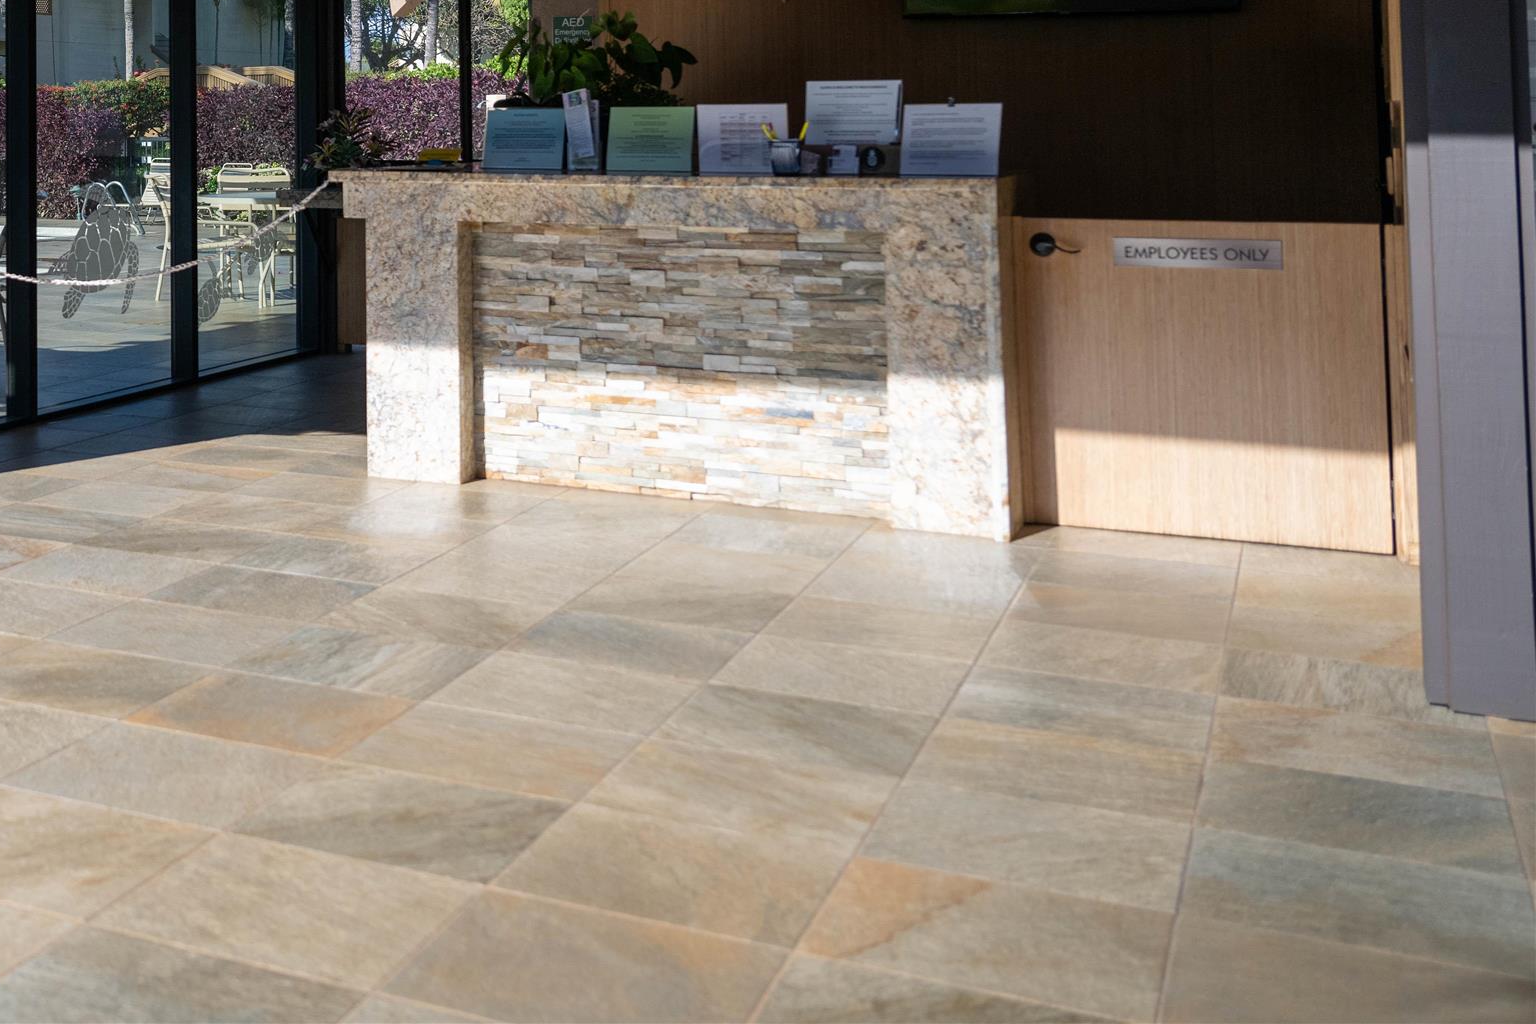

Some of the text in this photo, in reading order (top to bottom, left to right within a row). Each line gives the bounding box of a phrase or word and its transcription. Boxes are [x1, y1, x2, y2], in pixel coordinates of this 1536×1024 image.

[561, 17, 585, 27] AED
[1124, 245, 1270, 262] EMPLOYEES ONLY
